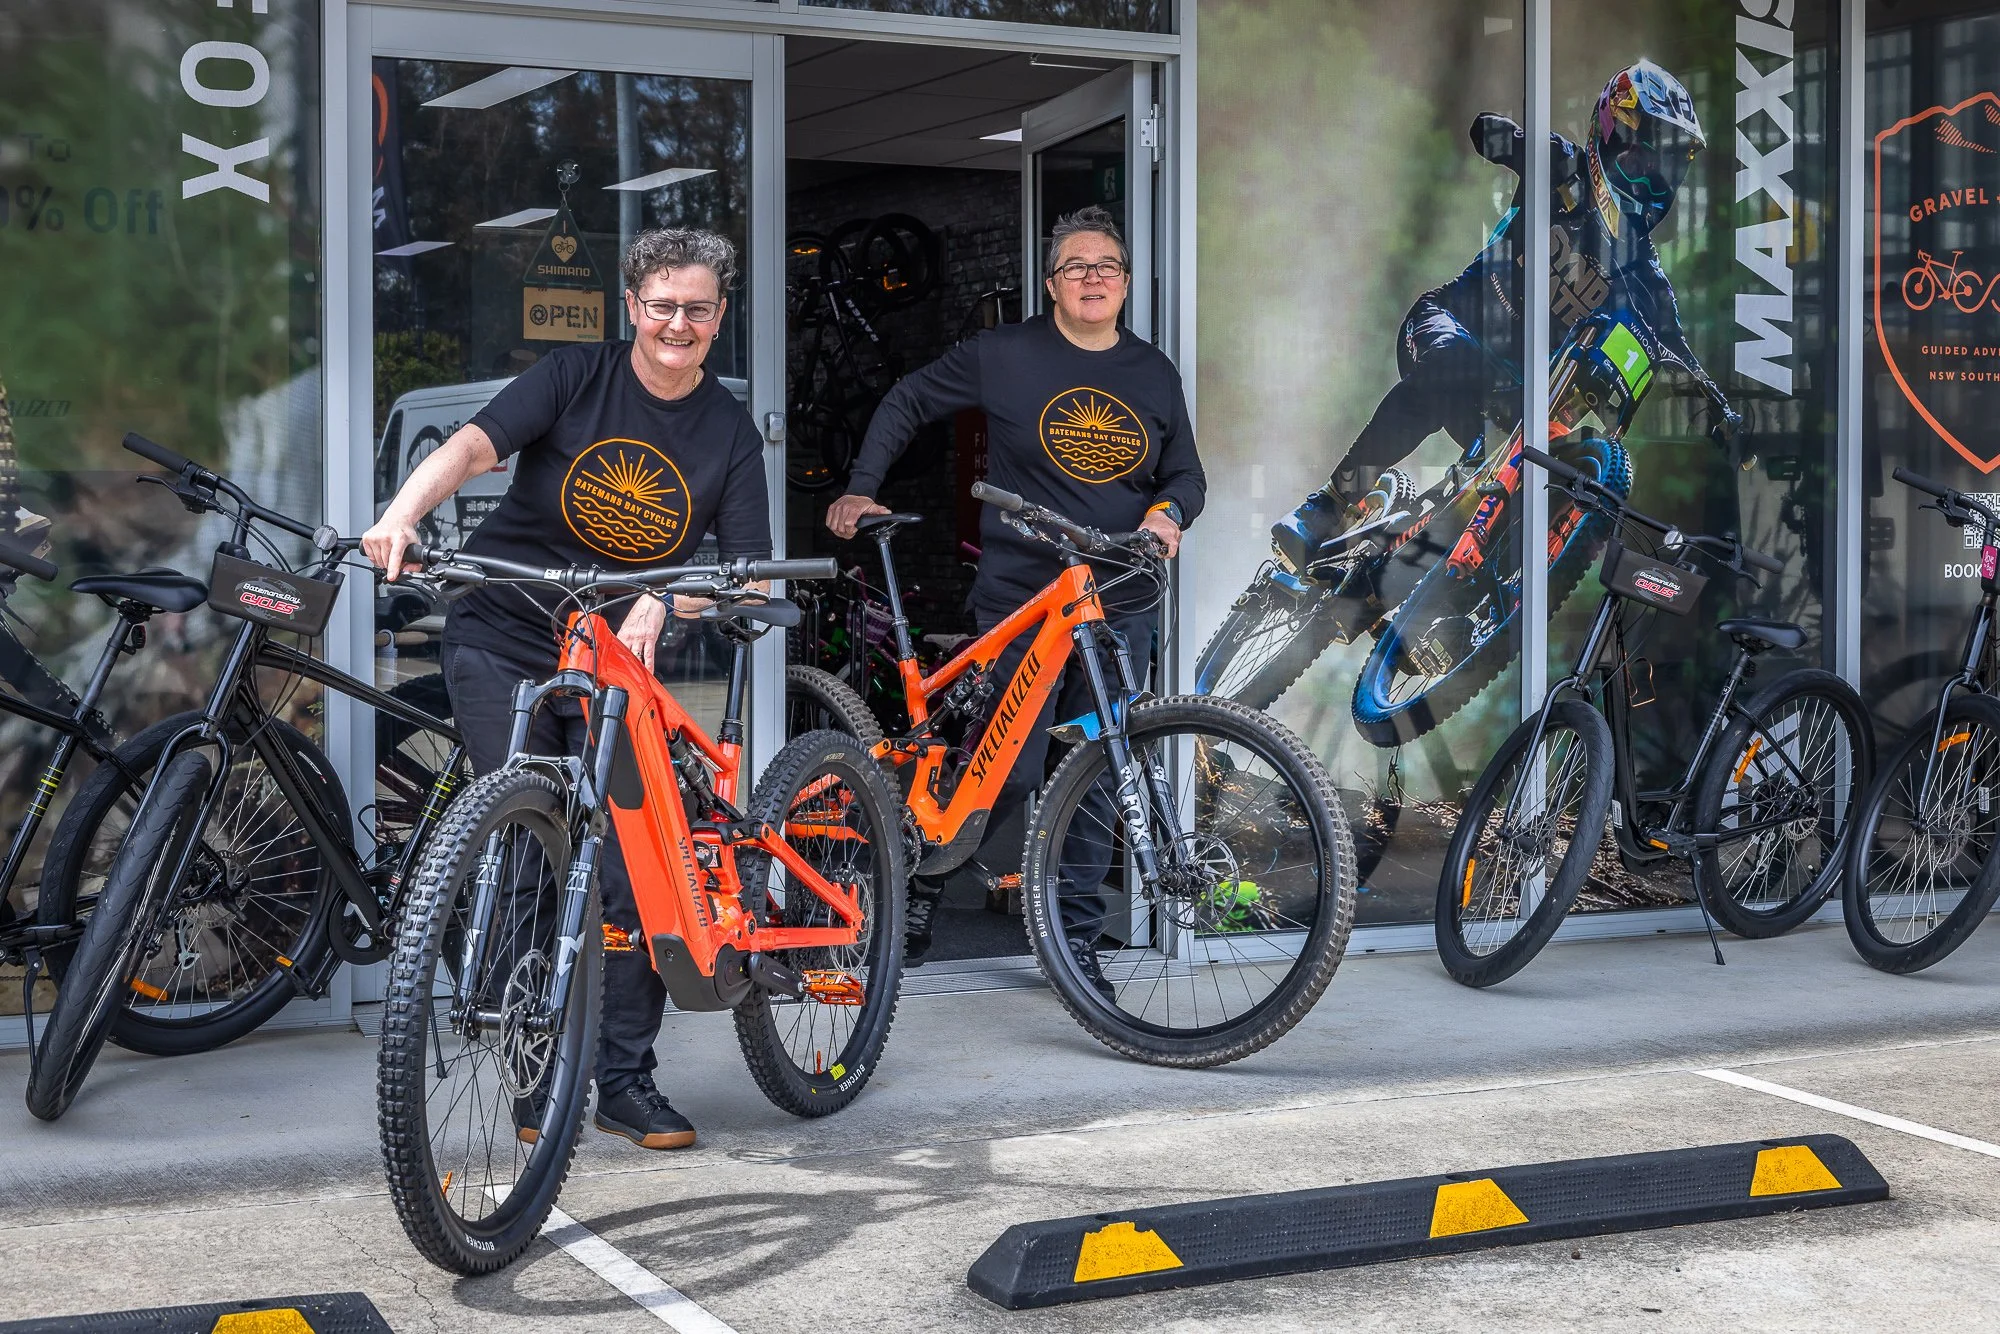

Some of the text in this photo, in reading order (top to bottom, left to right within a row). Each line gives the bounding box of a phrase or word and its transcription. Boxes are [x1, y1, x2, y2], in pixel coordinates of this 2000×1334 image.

[84, 186, 164, 235] Off
[1909, 188, 1989, 223] GRAVEL
[537, 264, 591, 277] SHIMANO
[1490, 272, 1521, 321] SHIMANO
[529, 304, 599, 329] OPEN
[845, 299, 879, 342] RAVEN
[1630, 322, 1656, 360] WHOOP
[1921, 345, 1968, 356] GUIDED
[1623, 348, 1639, 373] 1
[1929, 371, 2000, 382] NSW SOUTH
[974, 432, 986, 448] FI
[1049, 428, 1141, 447] BATEMANS BAY CYCLES
[974, 453, 988, 469] HO
[574, 478, 678, 530] BATEMANS BAY CYCLES
[1944, 563, 1982, 578] BOOK
[1635, 578, 1678, 598] CYCLES
[240, 592, 299, 615] CYCLES
[971, 650, 1041, 788] SPECIALIZED
[1121, 793, 1152, 846] FOX
[475, 863, 498, 886] Z1
[565, 870, 588, 893] Z1
[678, 836, 708, 927] SPECIALIZED
[1033, 885, 1048, 937] BUTCHER
[839, 1064, 866, 1092] BUTCHER
[464, 1232, 495, 1251] BUTCHER
